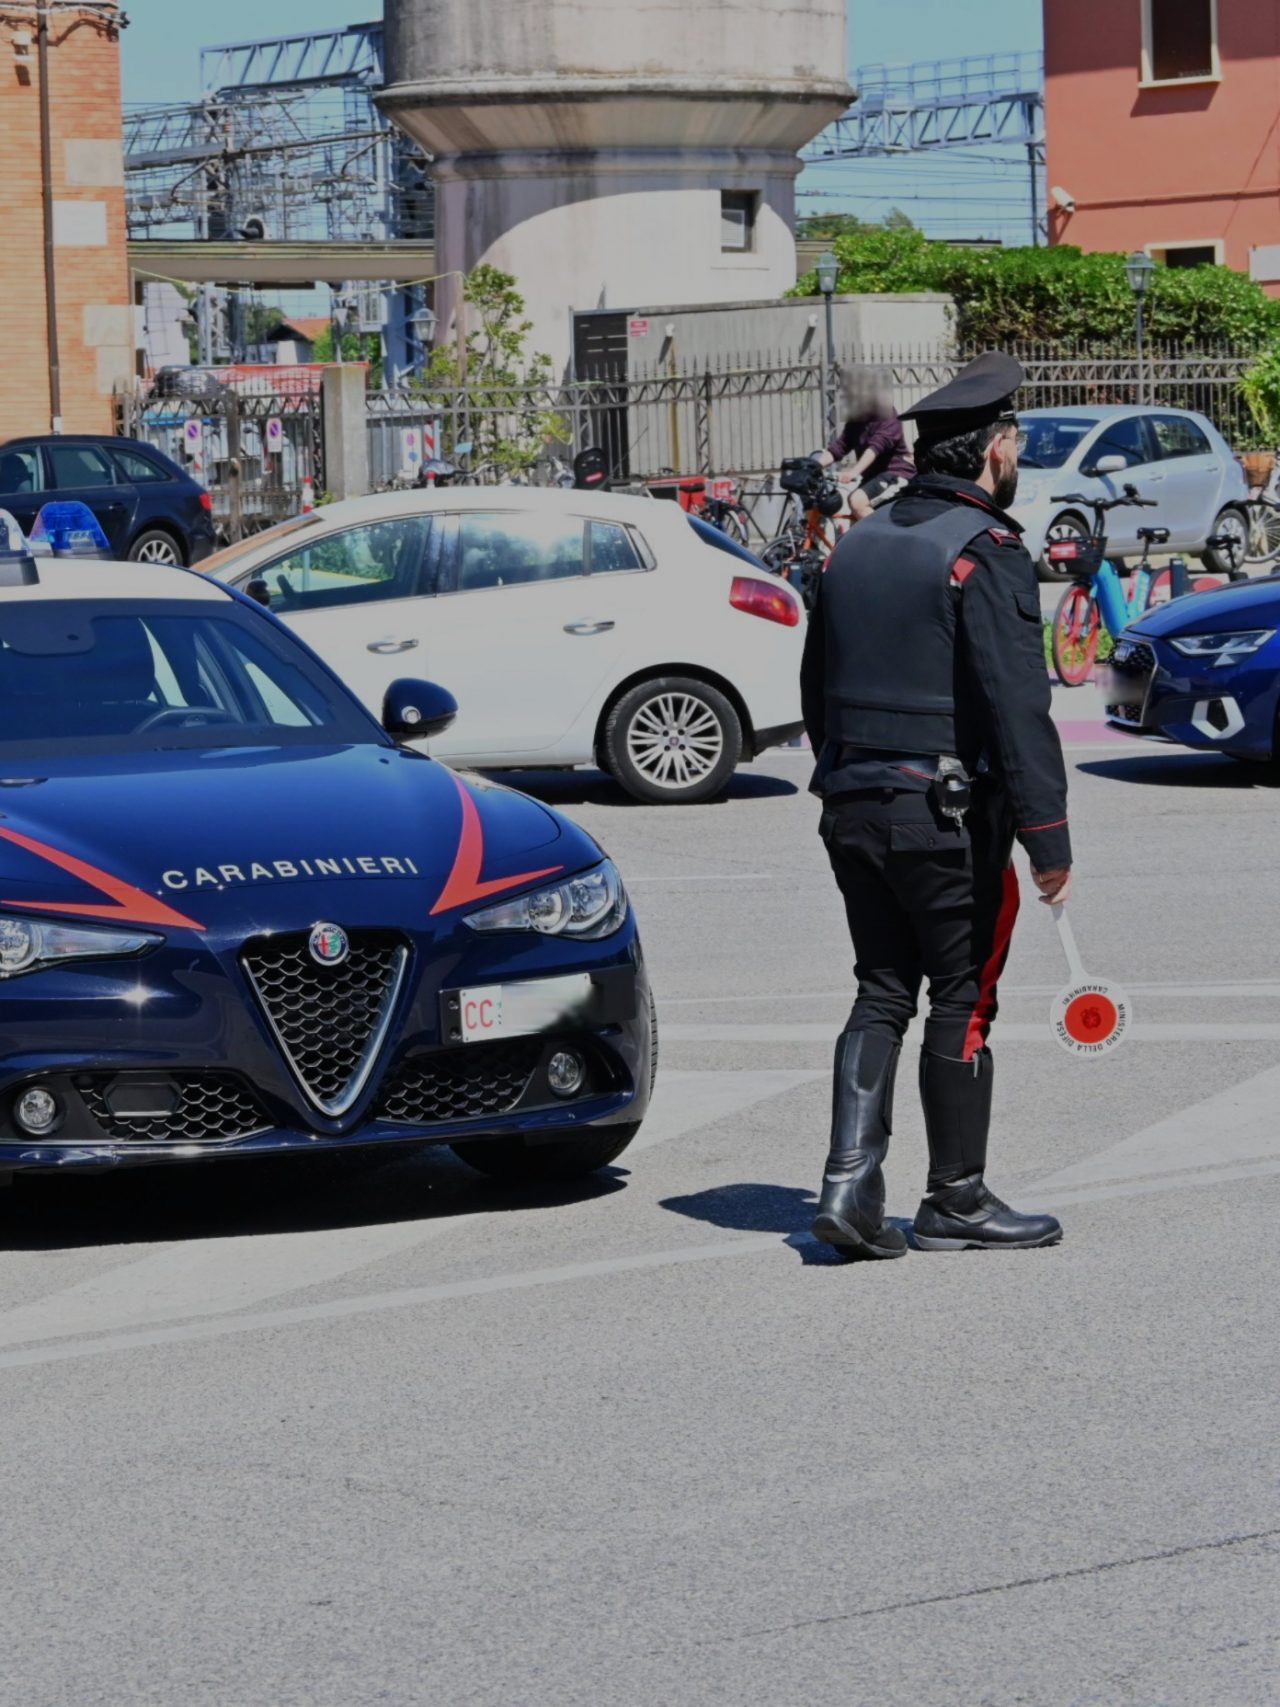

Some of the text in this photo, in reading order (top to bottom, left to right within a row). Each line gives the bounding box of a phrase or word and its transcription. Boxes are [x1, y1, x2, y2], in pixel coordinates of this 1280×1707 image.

[161, 857, 419, 890] CARABINIERI
[1062, 985, 1108, 1005] CARABINIERI
[464, 999, 494, 1030] CC
[1056, 1003, 1126, 1053] MINISTERO DELLA DIFESA
